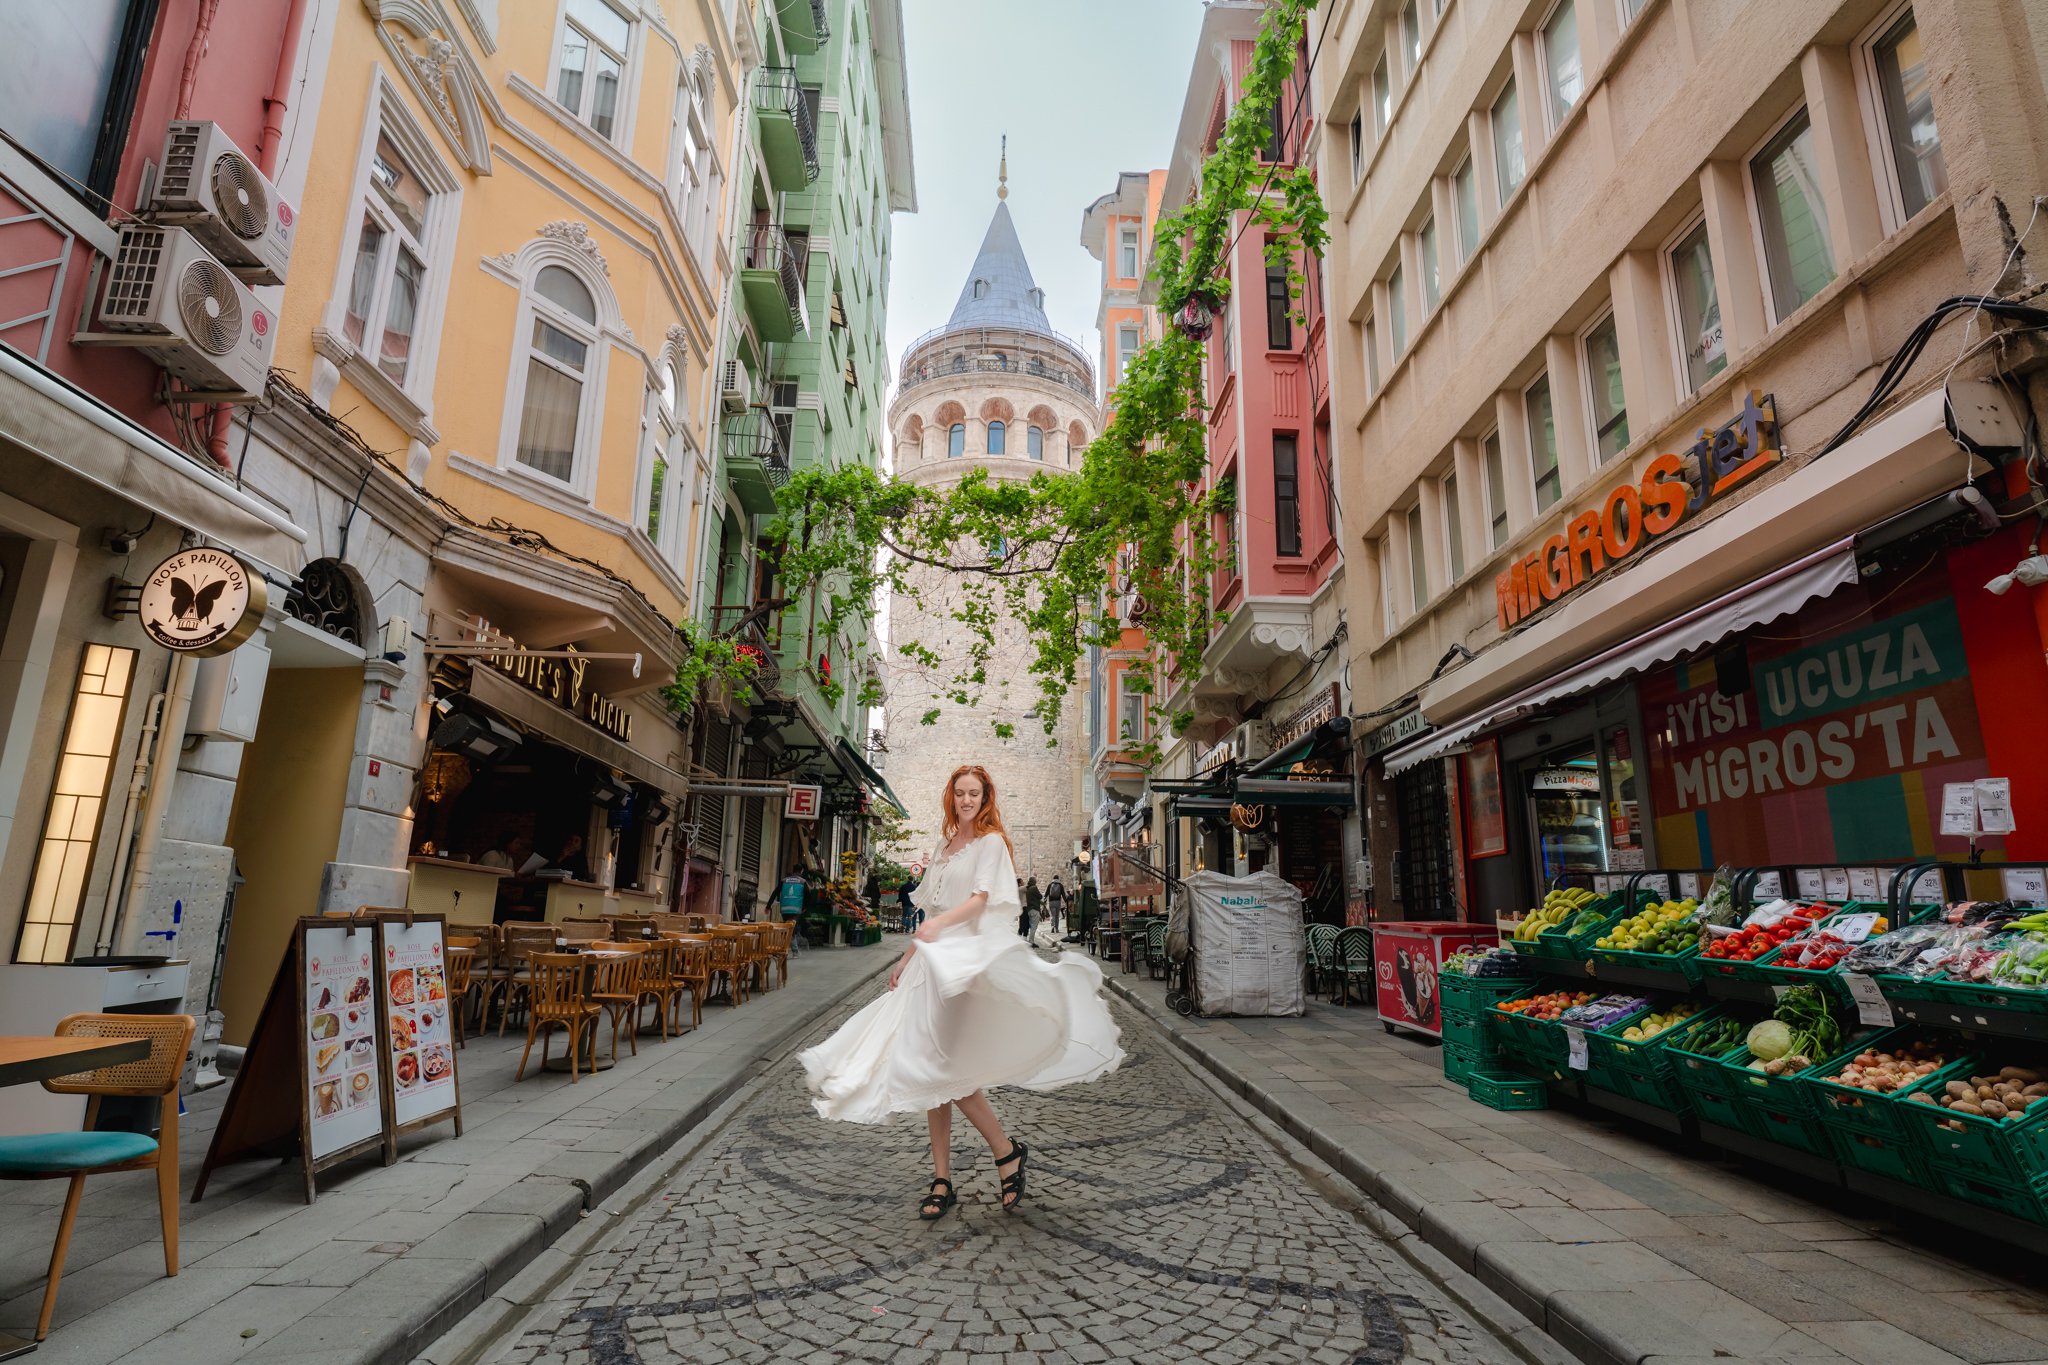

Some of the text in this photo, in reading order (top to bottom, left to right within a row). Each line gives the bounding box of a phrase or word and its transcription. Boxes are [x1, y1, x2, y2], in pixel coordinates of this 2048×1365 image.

[275, 221, 288, 240] LG
[249, 333, 263, 350] LG
[153, 553, 243, 592] ROSE PAPILLON
[158, 632, 178, 645] coffee
[185, 635, 211, 647] dessert
[1764, 622, 1942, 717] UCUZA
[590, 692, 632, 742] CUCINA
[794, 791, 812, 812] E
[1221, 896, 1268, 906] Nabaltec
